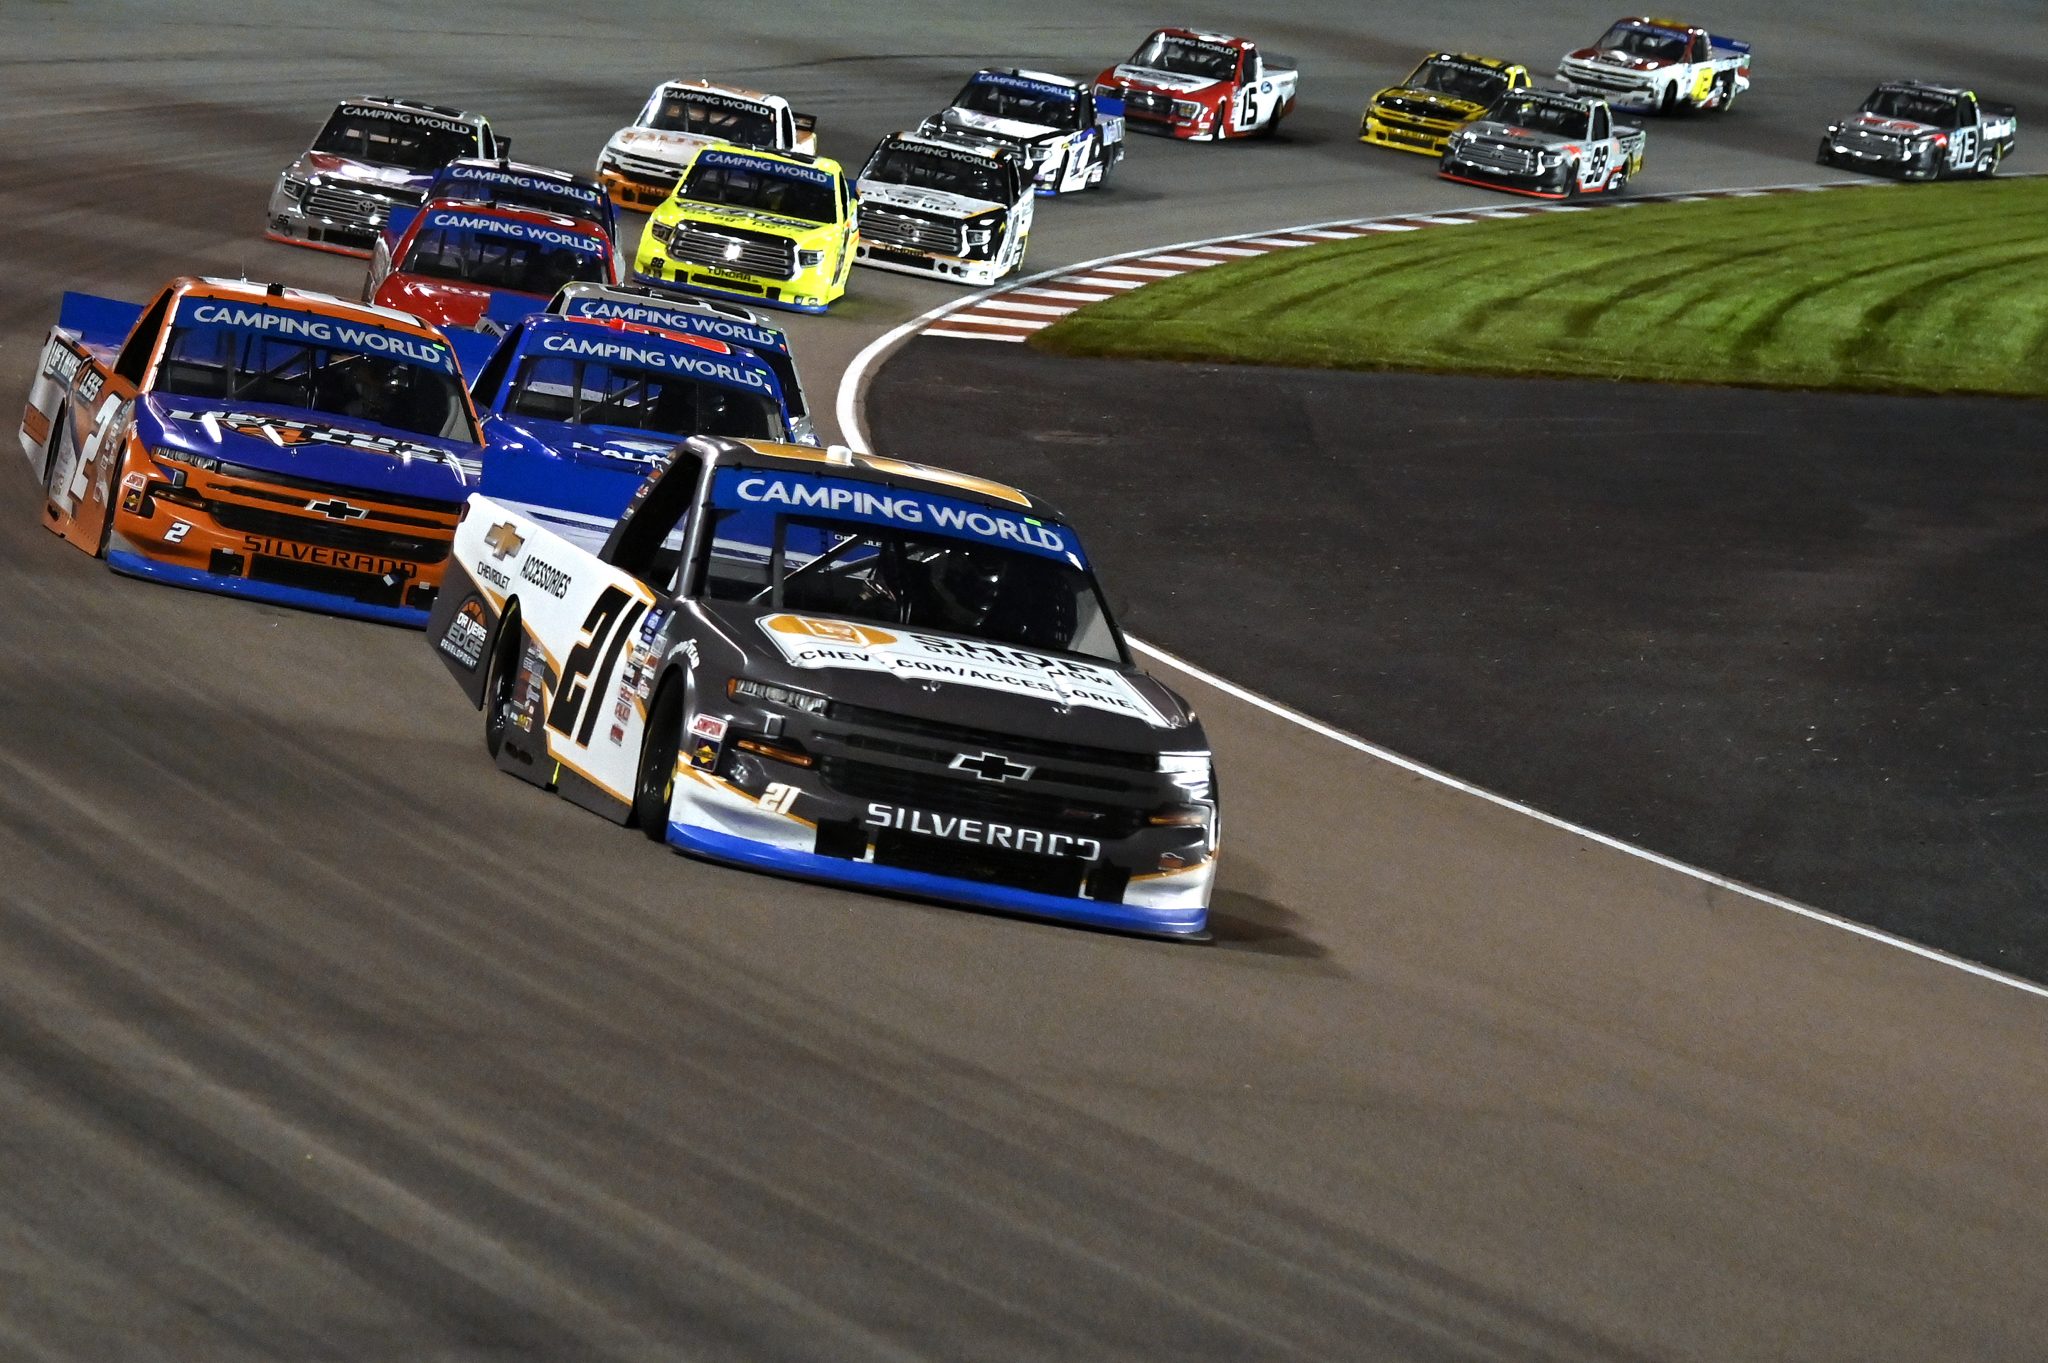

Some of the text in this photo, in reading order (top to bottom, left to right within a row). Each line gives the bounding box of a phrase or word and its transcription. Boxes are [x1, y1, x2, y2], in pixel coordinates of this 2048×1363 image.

[1198, 42, 1233, 55] WORLD
[979, 73, 1029, 89] CAMPING
[342, 106, 470, 135] CAMPING WORLD
[664, 90, 769, 116] CAMPING WORLD
[1241, 87, 1258, 126] 15
[705, 152, 828, 184] CAMPING WORLD
[888, 141, 999, 170] CAMPING WORLD
[452, 168, 529, 188] CAMPING
[434, 214, 597, 252] CAMPING WORLD
[707, 267, 751, 281] TUNDRA
[194, 306, 331, 340] CAMPING
[336, 326, 440, 363] WORLD
[580, 302, 774, 346] CAMPING WORLD
[543, 336, 764, 388] CAMPING WORLD
[69, 392, 122, 501] 2
[164, 521, 192, 544] 2
[737, 478, 1064, 552] CAMPING WORLD
[477, 561, 511, 590] CHEVROLET
[520, 554, 572, 600] ACCESSORIES
[440, 638, 477, 667] DEVELOPMENT
[447, 622, 484, 659] EDGE
[909, 633, 1100, 675] SHOP
[544, 584, 651, 750] 21
[923, 645, 1114, 687] ONLINE NOW
[758, 782, 802, 815] 21
